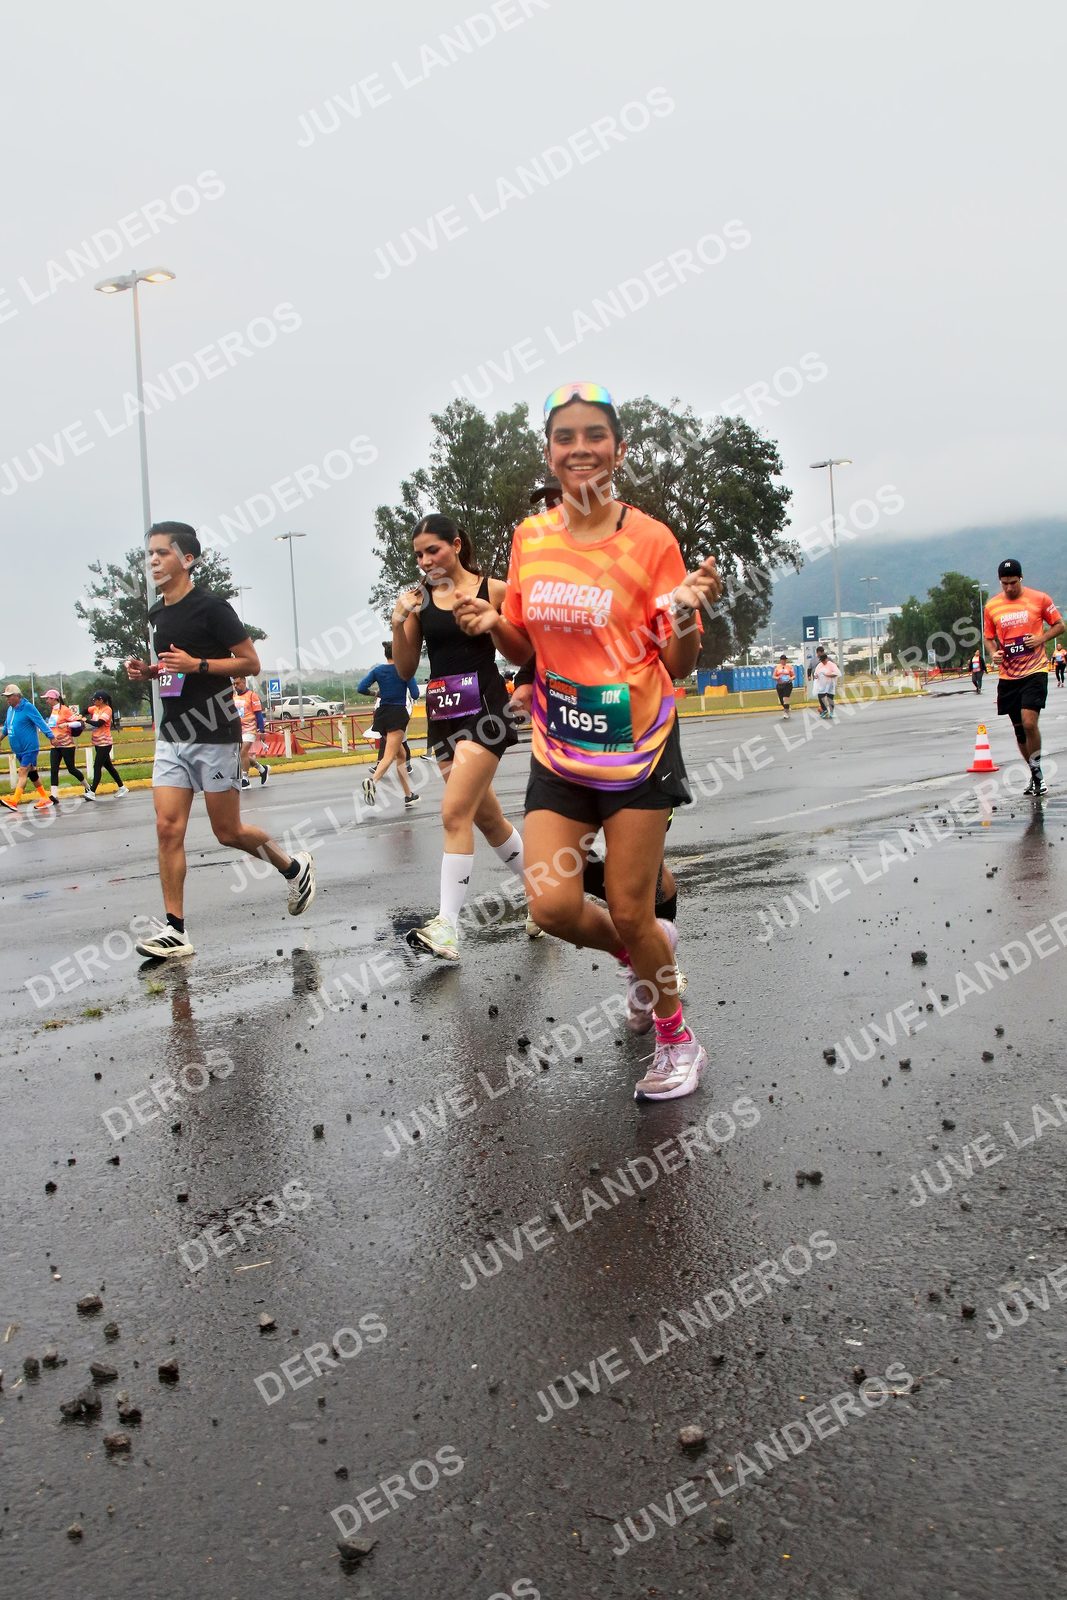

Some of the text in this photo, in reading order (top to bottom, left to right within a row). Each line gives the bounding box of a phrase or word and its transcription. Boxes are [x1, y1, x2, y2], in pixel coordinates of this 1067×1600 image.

[528, 580, 613, 609] CARRERA
[806, 627, 815, 638] E
[1010, 645, 1024, 653] 675
[437, 692, 461, 708] 247
[601, 690, 621, 704] 10K
[559, 706, 608, 733] 1695
